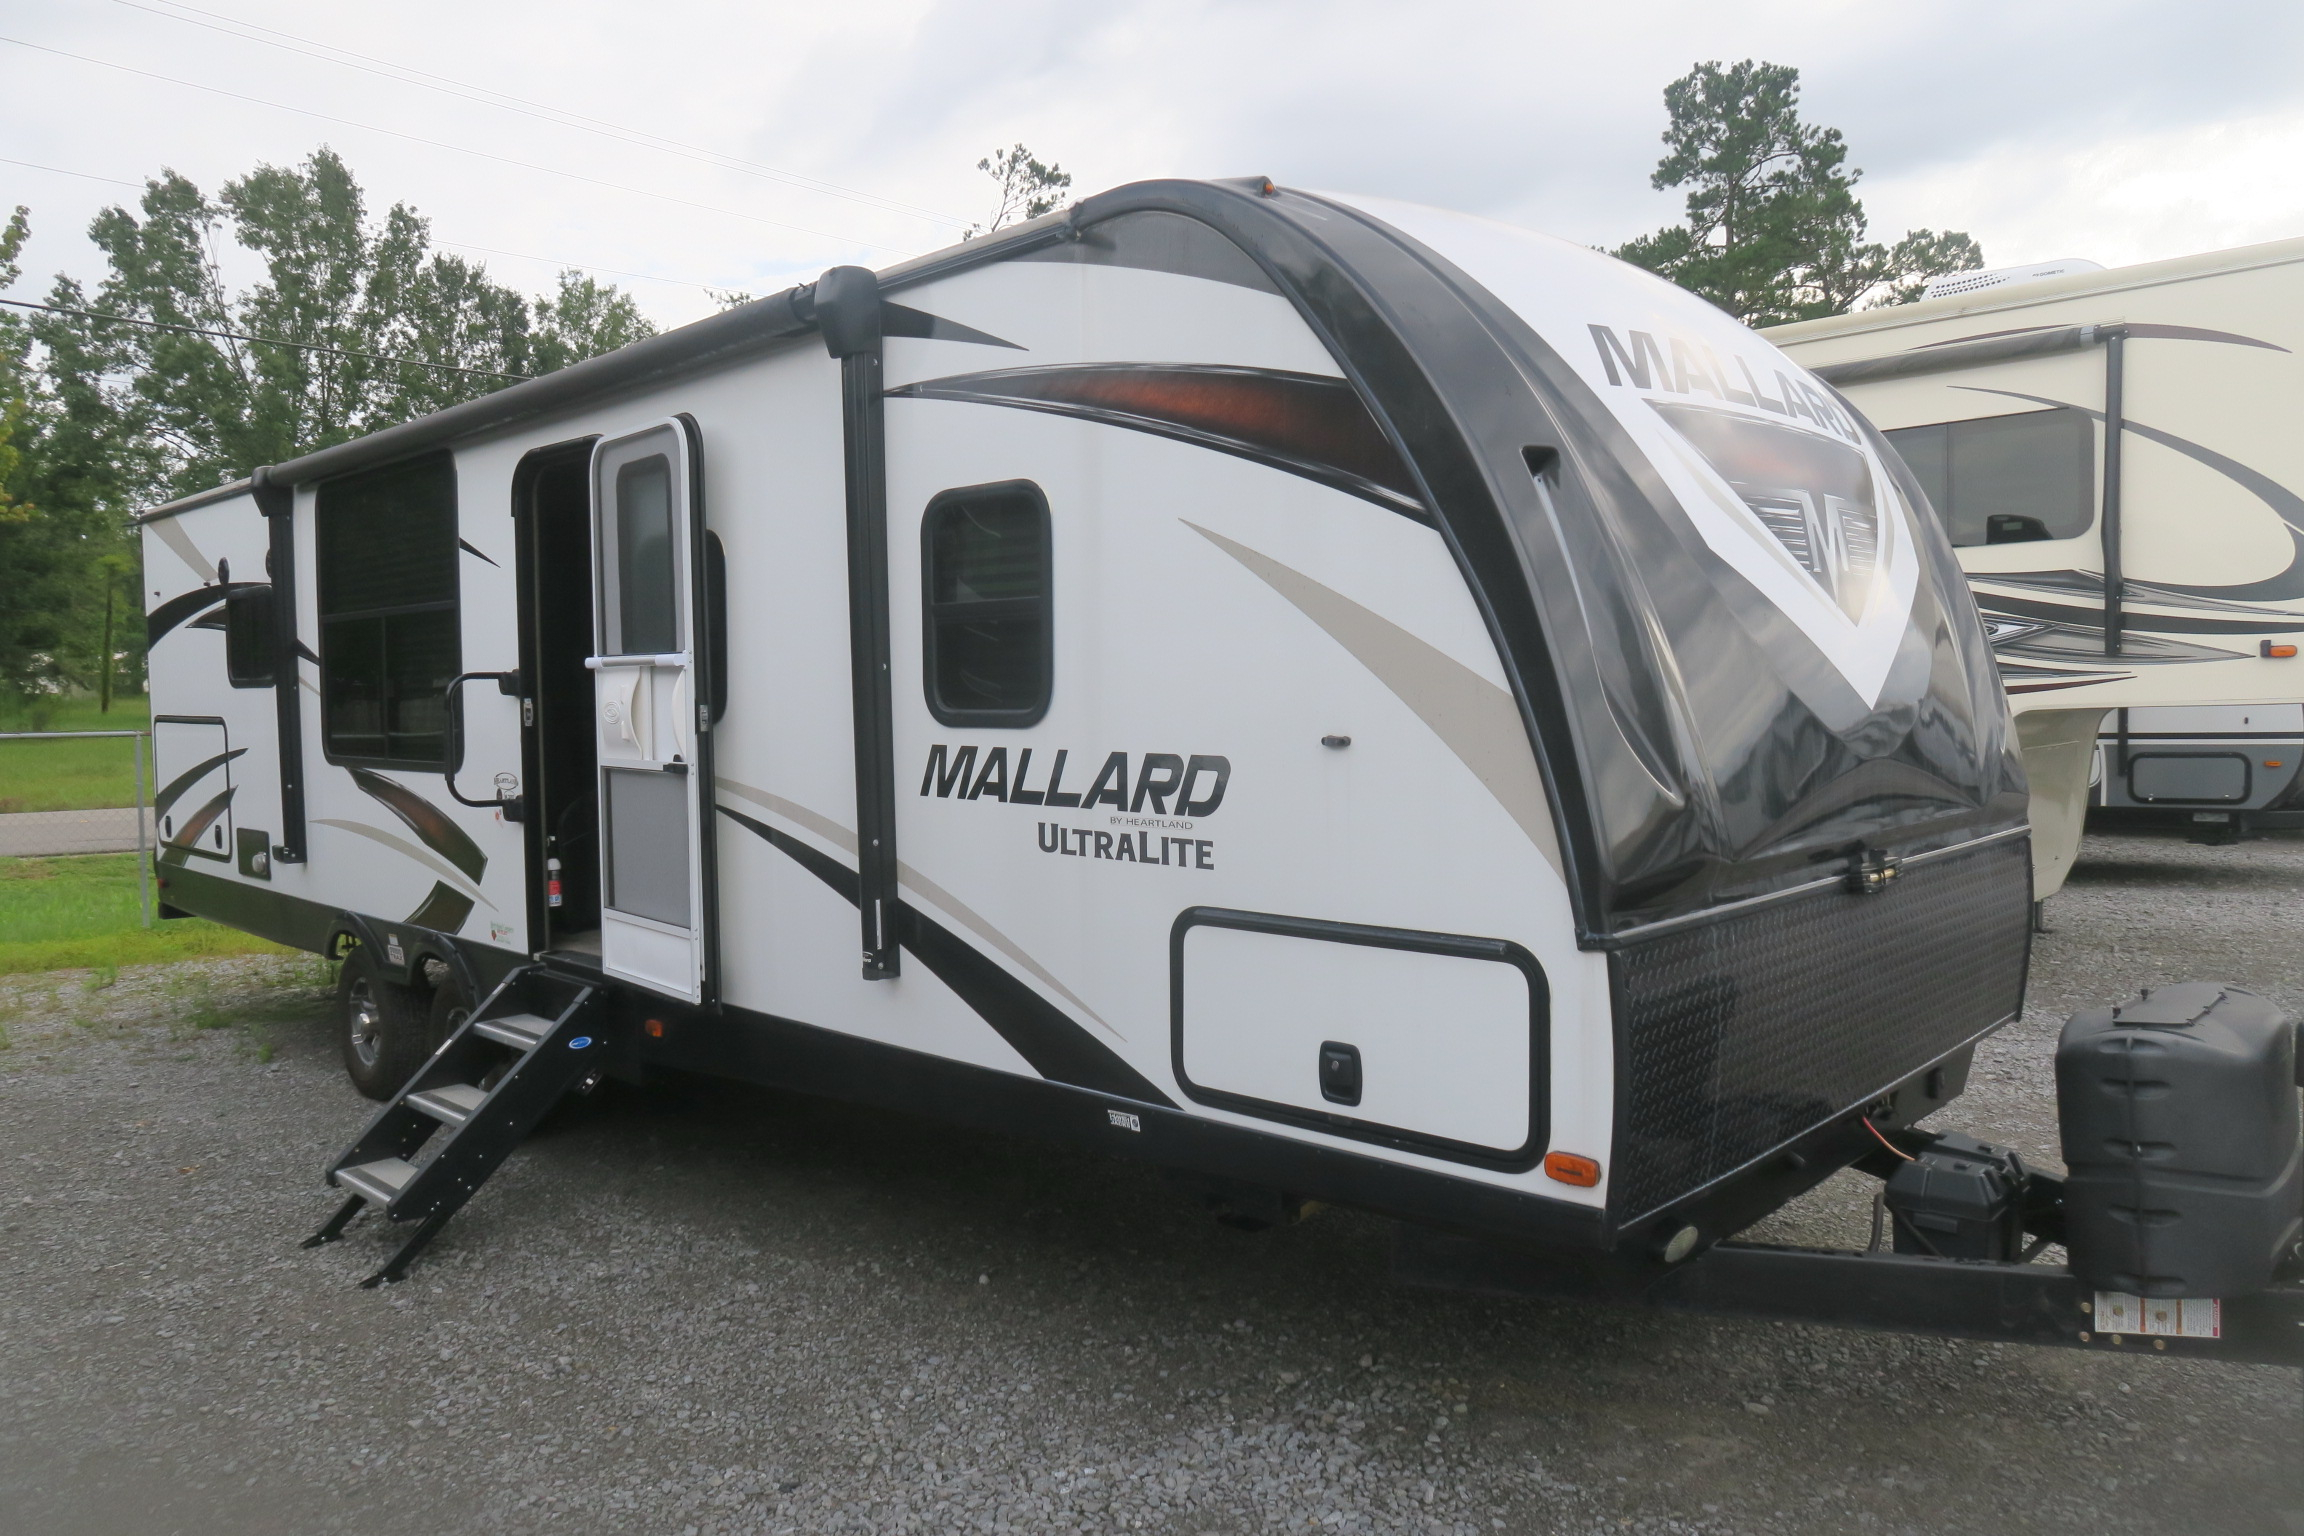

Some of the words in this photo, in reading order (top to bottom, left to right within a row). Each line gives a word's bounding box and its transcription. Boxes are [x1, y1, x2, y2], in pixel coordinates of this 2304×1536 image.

[2039, 268, 2065, 277] DOMETIC
[1587, 323, 1862, 446] MALLARD
[920, 744, 1231, 818] MALLARD
[1109, 816, 1123, 825] BY
[1126, 818, 1194, 830] HEARTLAND
